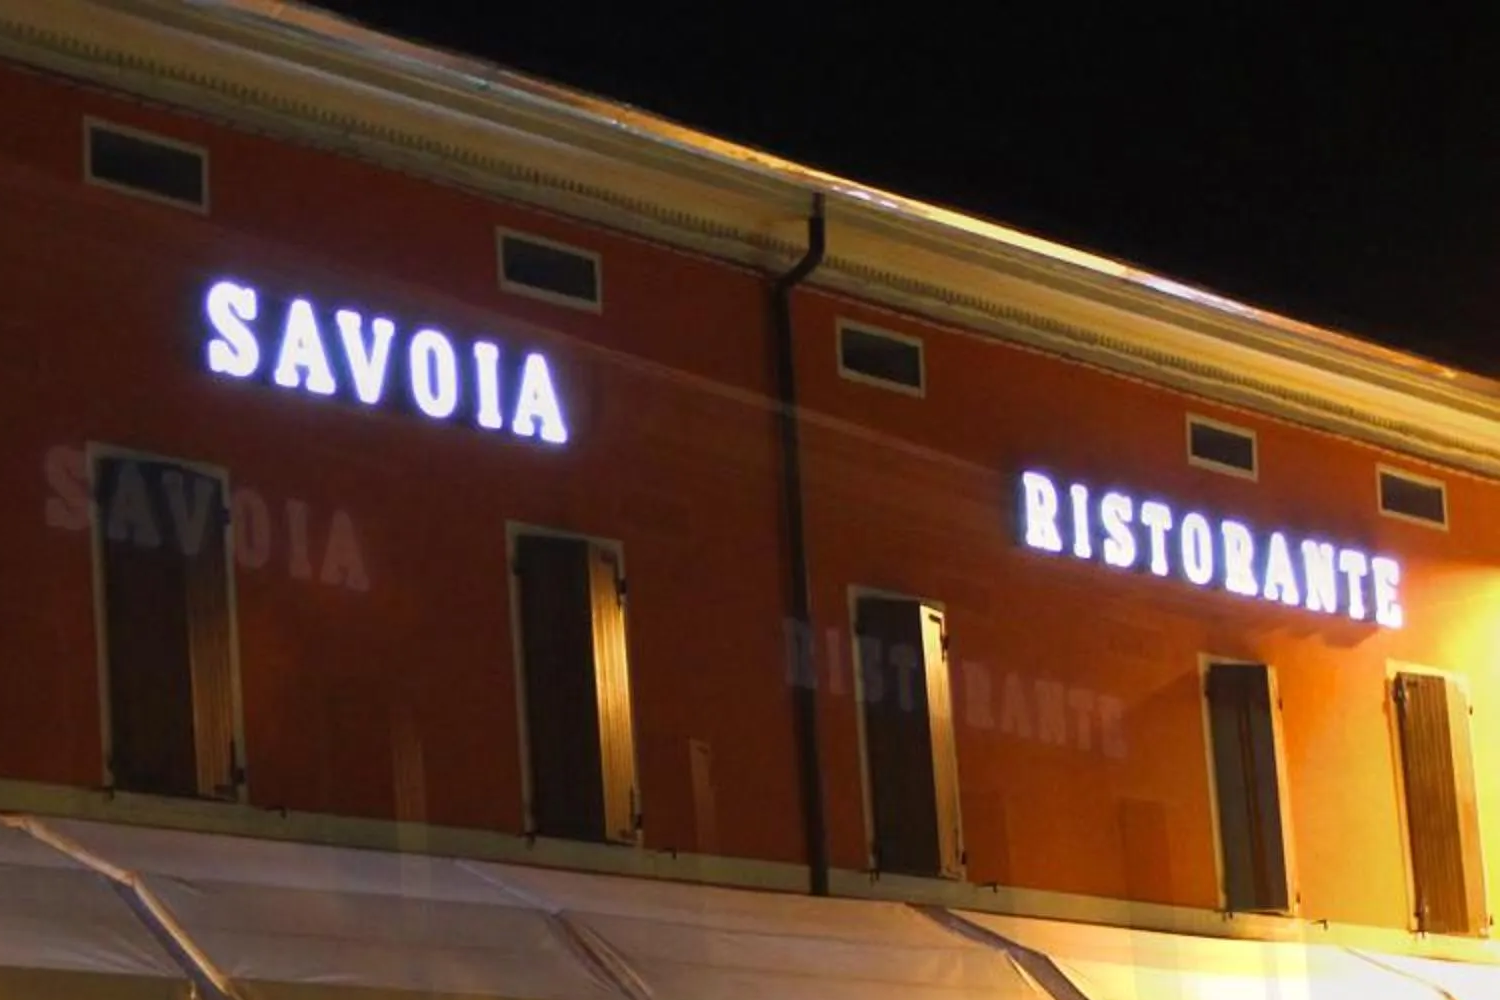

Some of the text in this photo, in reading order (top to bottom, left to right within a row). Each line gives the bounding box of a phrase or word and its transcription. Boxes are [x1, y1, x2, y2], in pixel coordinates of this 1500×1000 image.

[205, 280, 568, 444] SAVOIA
[45, 446, 371, 592] SAVOIA
[1021, 471, 1404, 630] RISTORANTE
[782, 617, 1129, 760] RISTRANTE
